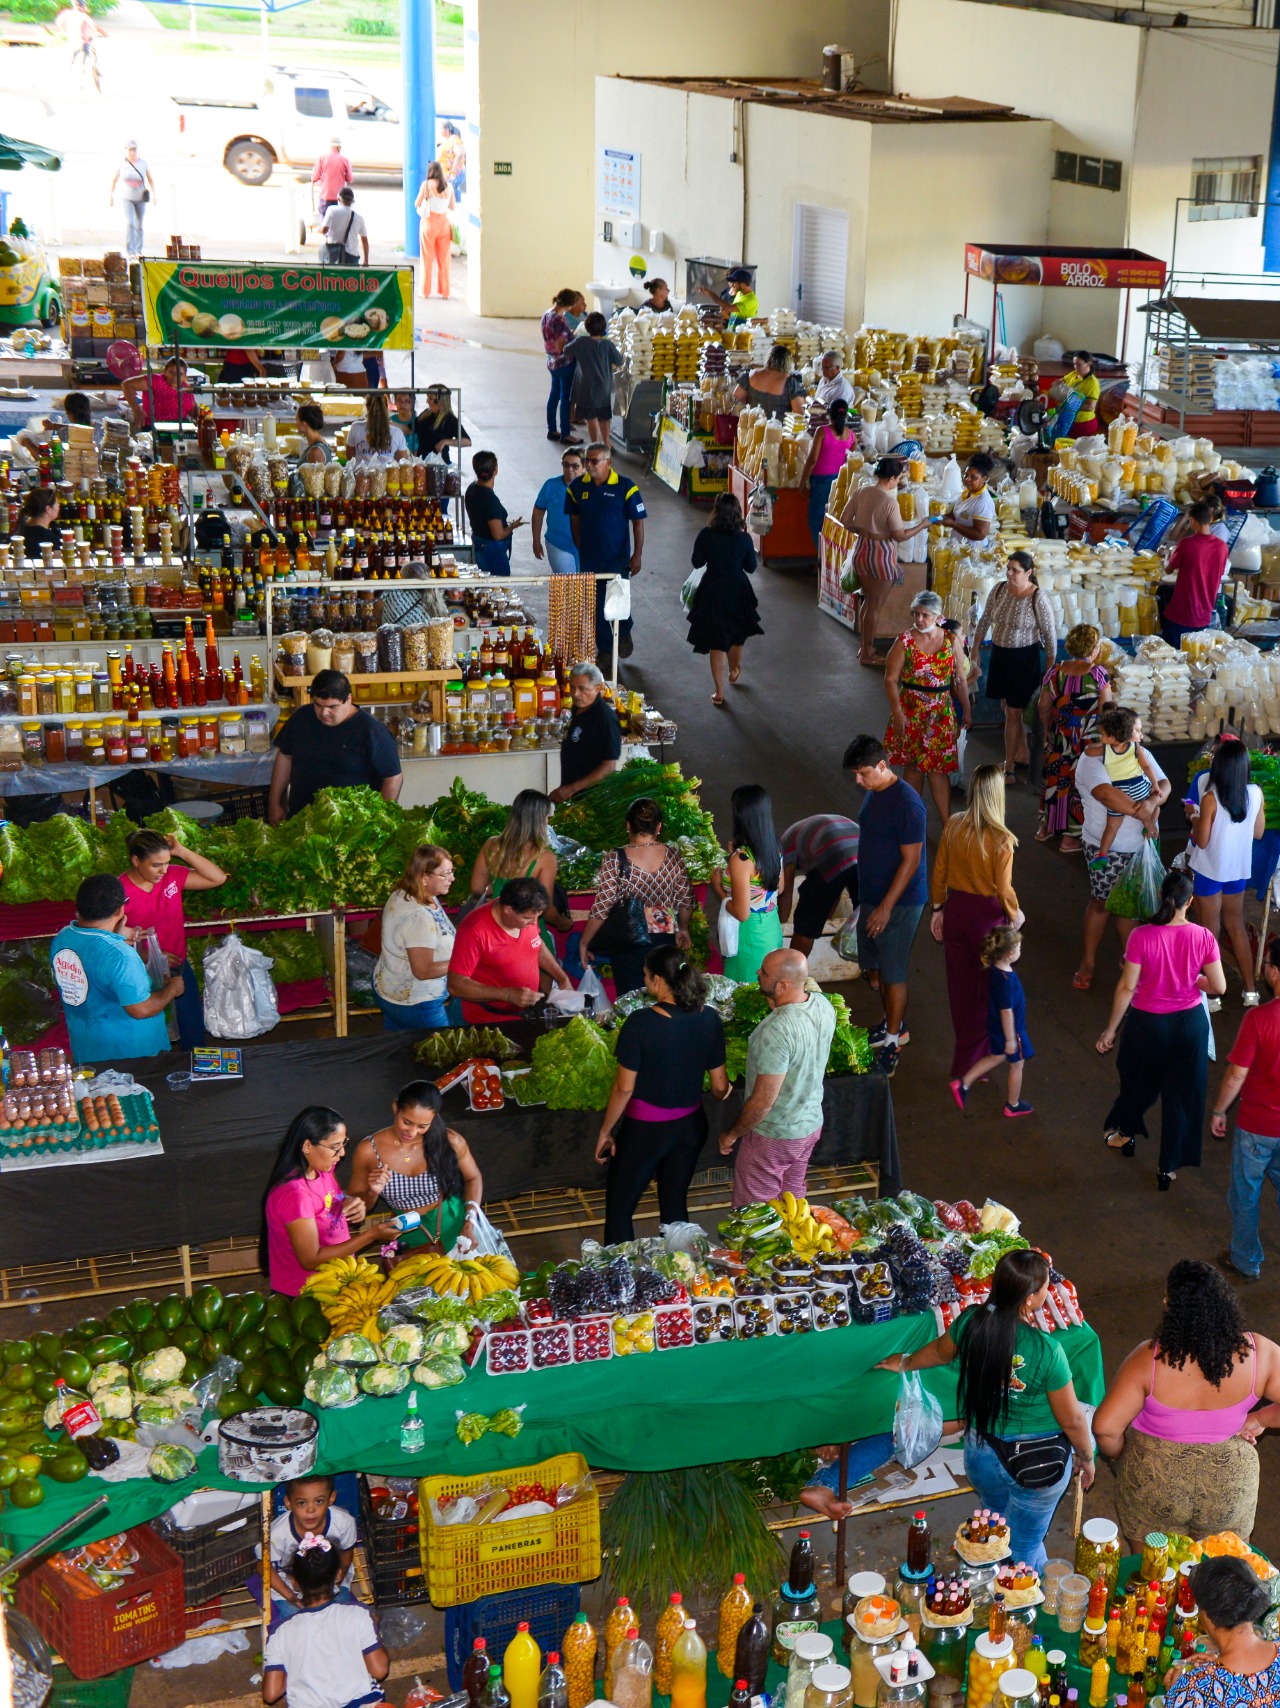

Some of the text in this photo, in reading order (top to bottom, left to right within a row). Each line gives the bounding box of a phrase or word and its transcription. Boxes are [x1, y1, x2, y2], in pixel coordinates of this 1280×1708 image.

[494, 163, 512, 173] SAÍDA
[1061, 262, 1091, 275] BOLO
[179, 267, 380, 293] Queijos Colmeia
[1066, 274, 1106, 287] ARROZ
[491, 1538, 542, 1553] PANEBRAS
